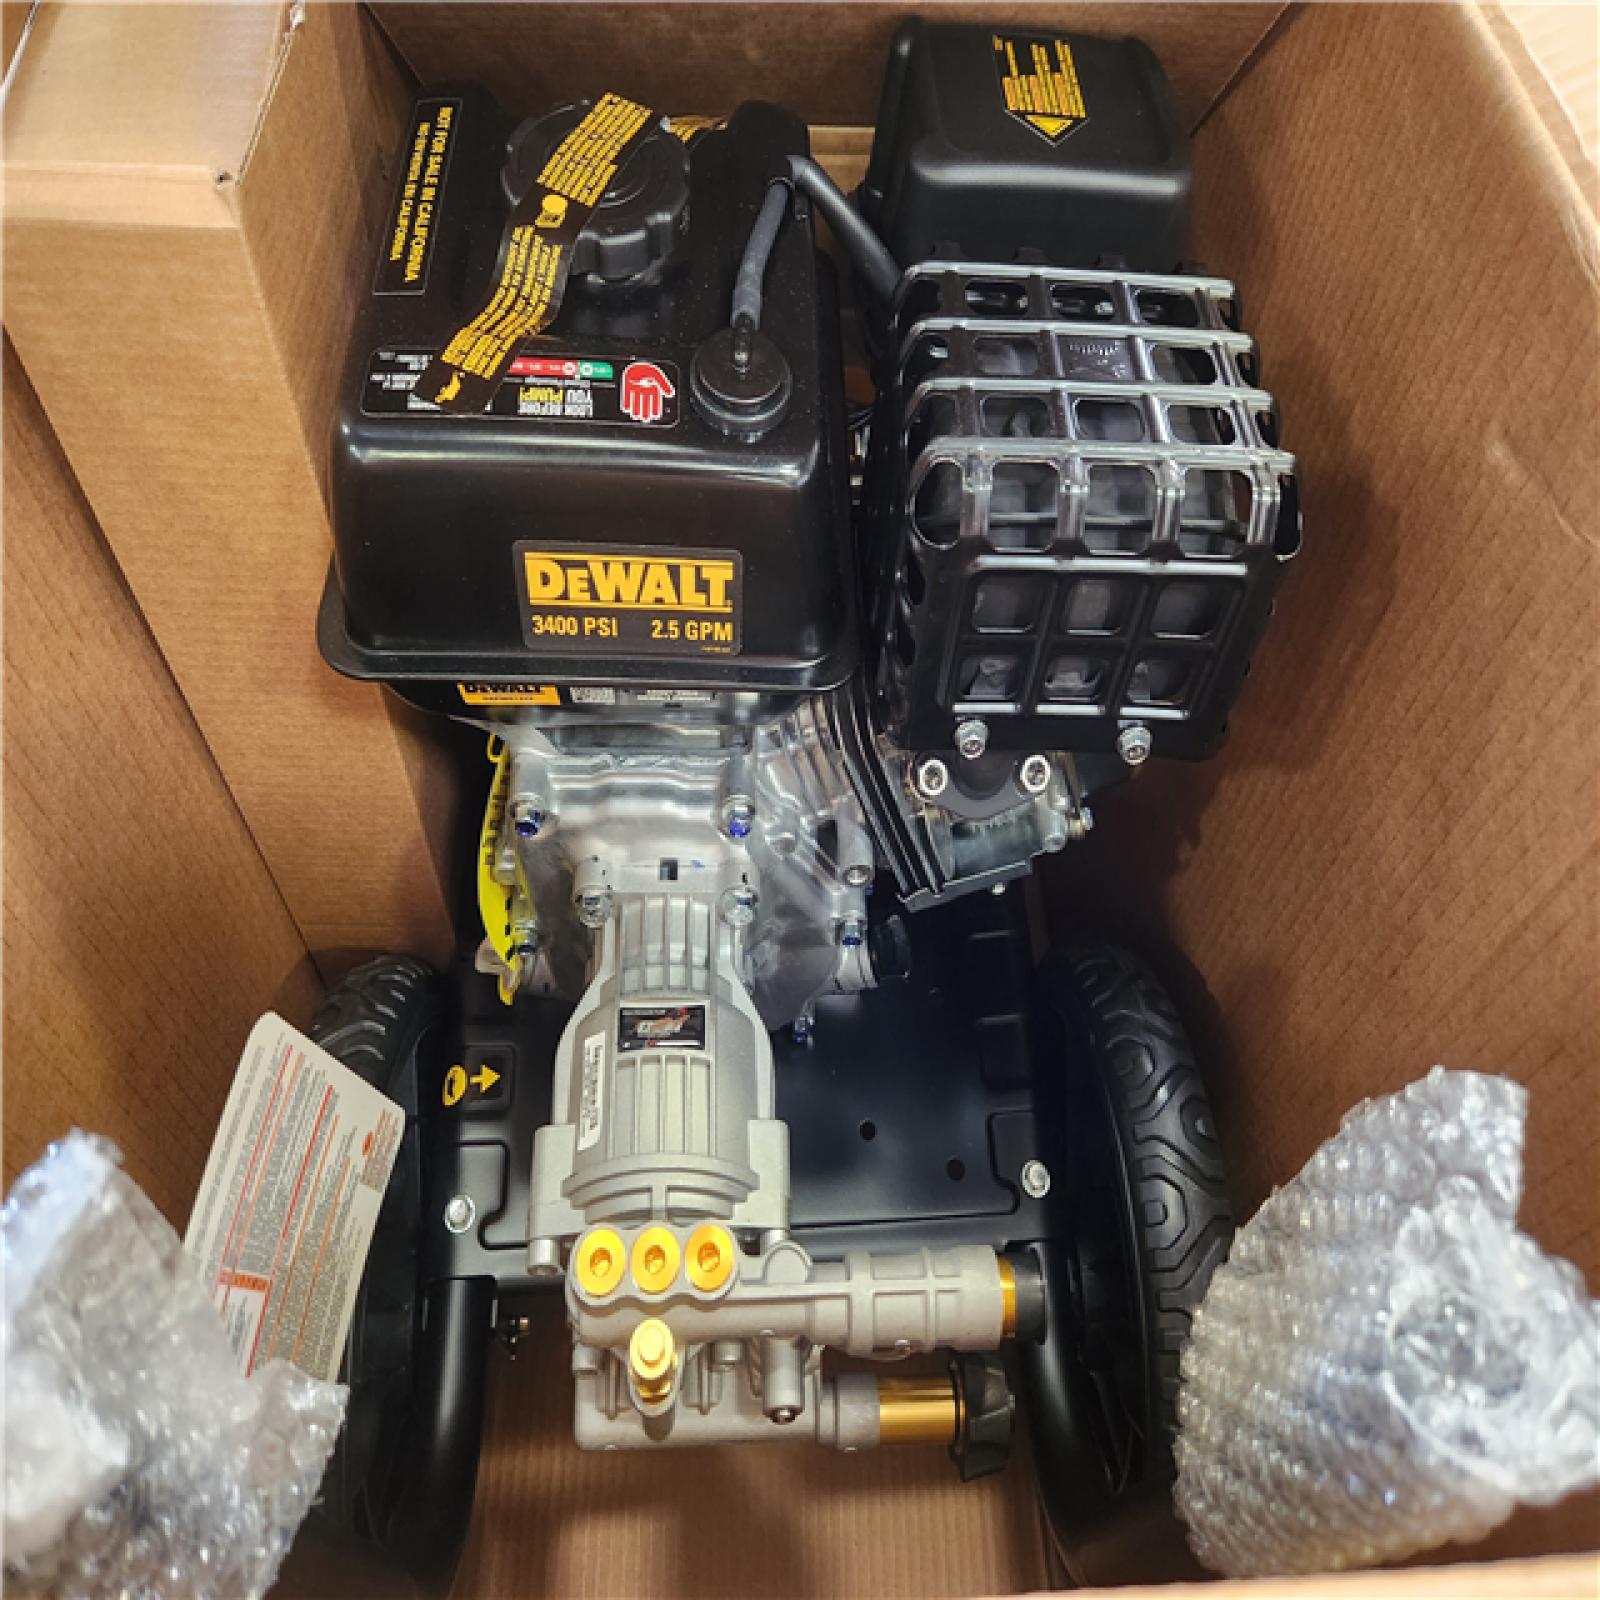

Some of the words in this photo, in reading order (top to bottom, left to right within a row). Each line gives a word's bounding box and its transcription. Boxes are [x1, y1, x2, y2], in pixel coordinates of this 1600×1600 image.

[437, 107, 453, 128] NOT
[431, 130, 448, 153] FOR
[424, 154, 443, 185] SALE
[420, 187, 436, 200] IN
[390, 199, 413, 261] CALIFORNIA
[404, 202, 432, 282] CALIFORNIA
[565, 389, 592, 404] YOU
[532, 614, 579, 636] 3400
[584, 616, 619, 638] PSI
[651, 619, 681, 640] 2.5
[685, 621, 733, 642] GPM
